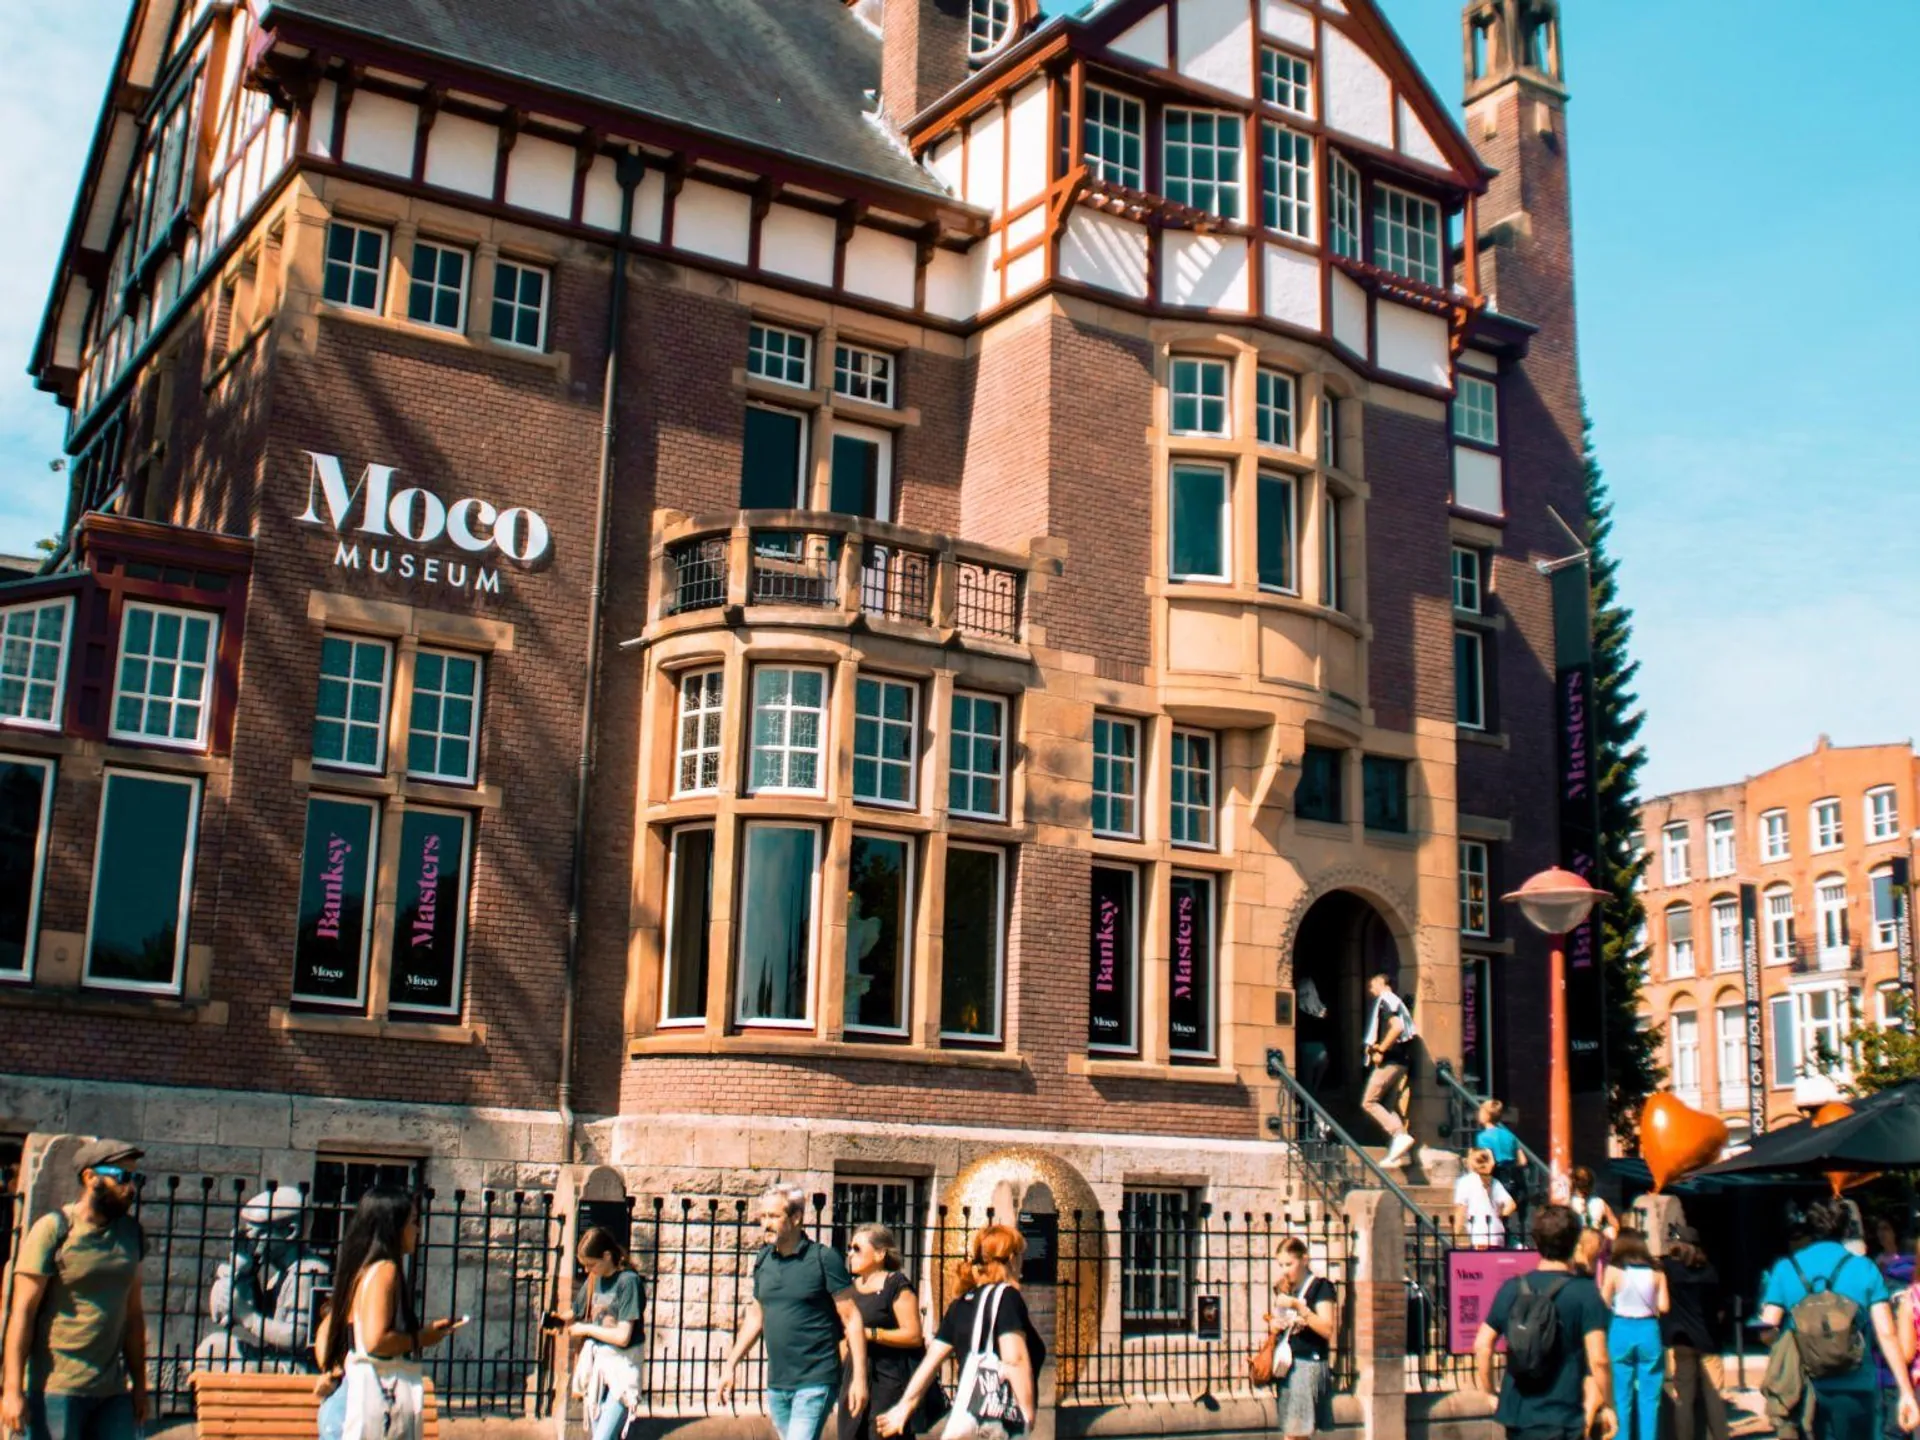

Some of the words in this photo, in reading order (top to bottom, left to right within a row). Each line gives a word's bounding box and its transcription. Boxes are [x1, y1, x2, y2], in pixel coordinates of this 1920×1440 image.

[292, 450, 549, 561] Moco
[333, 541, 500, 594] MUSEUM
[1566, 671, 1587, 799] Masters
[316, 832, 352, 940] Banksy
[412, 834, 441, 949] Masters
[1096, 896, 1119, 992] Banksy
[1174, 896, 1193, 1000] Masters
[310, 965, 344, 979] Moco
[405, 973, 438, 987] Moco
[1093, 1015, 1119, 1028] Moco
[1172, 1022, 1196, 1033] Moco
[1748, 1006, 1761, 1046] BOLS
[1751, 1062, 1762, 1086] OF
